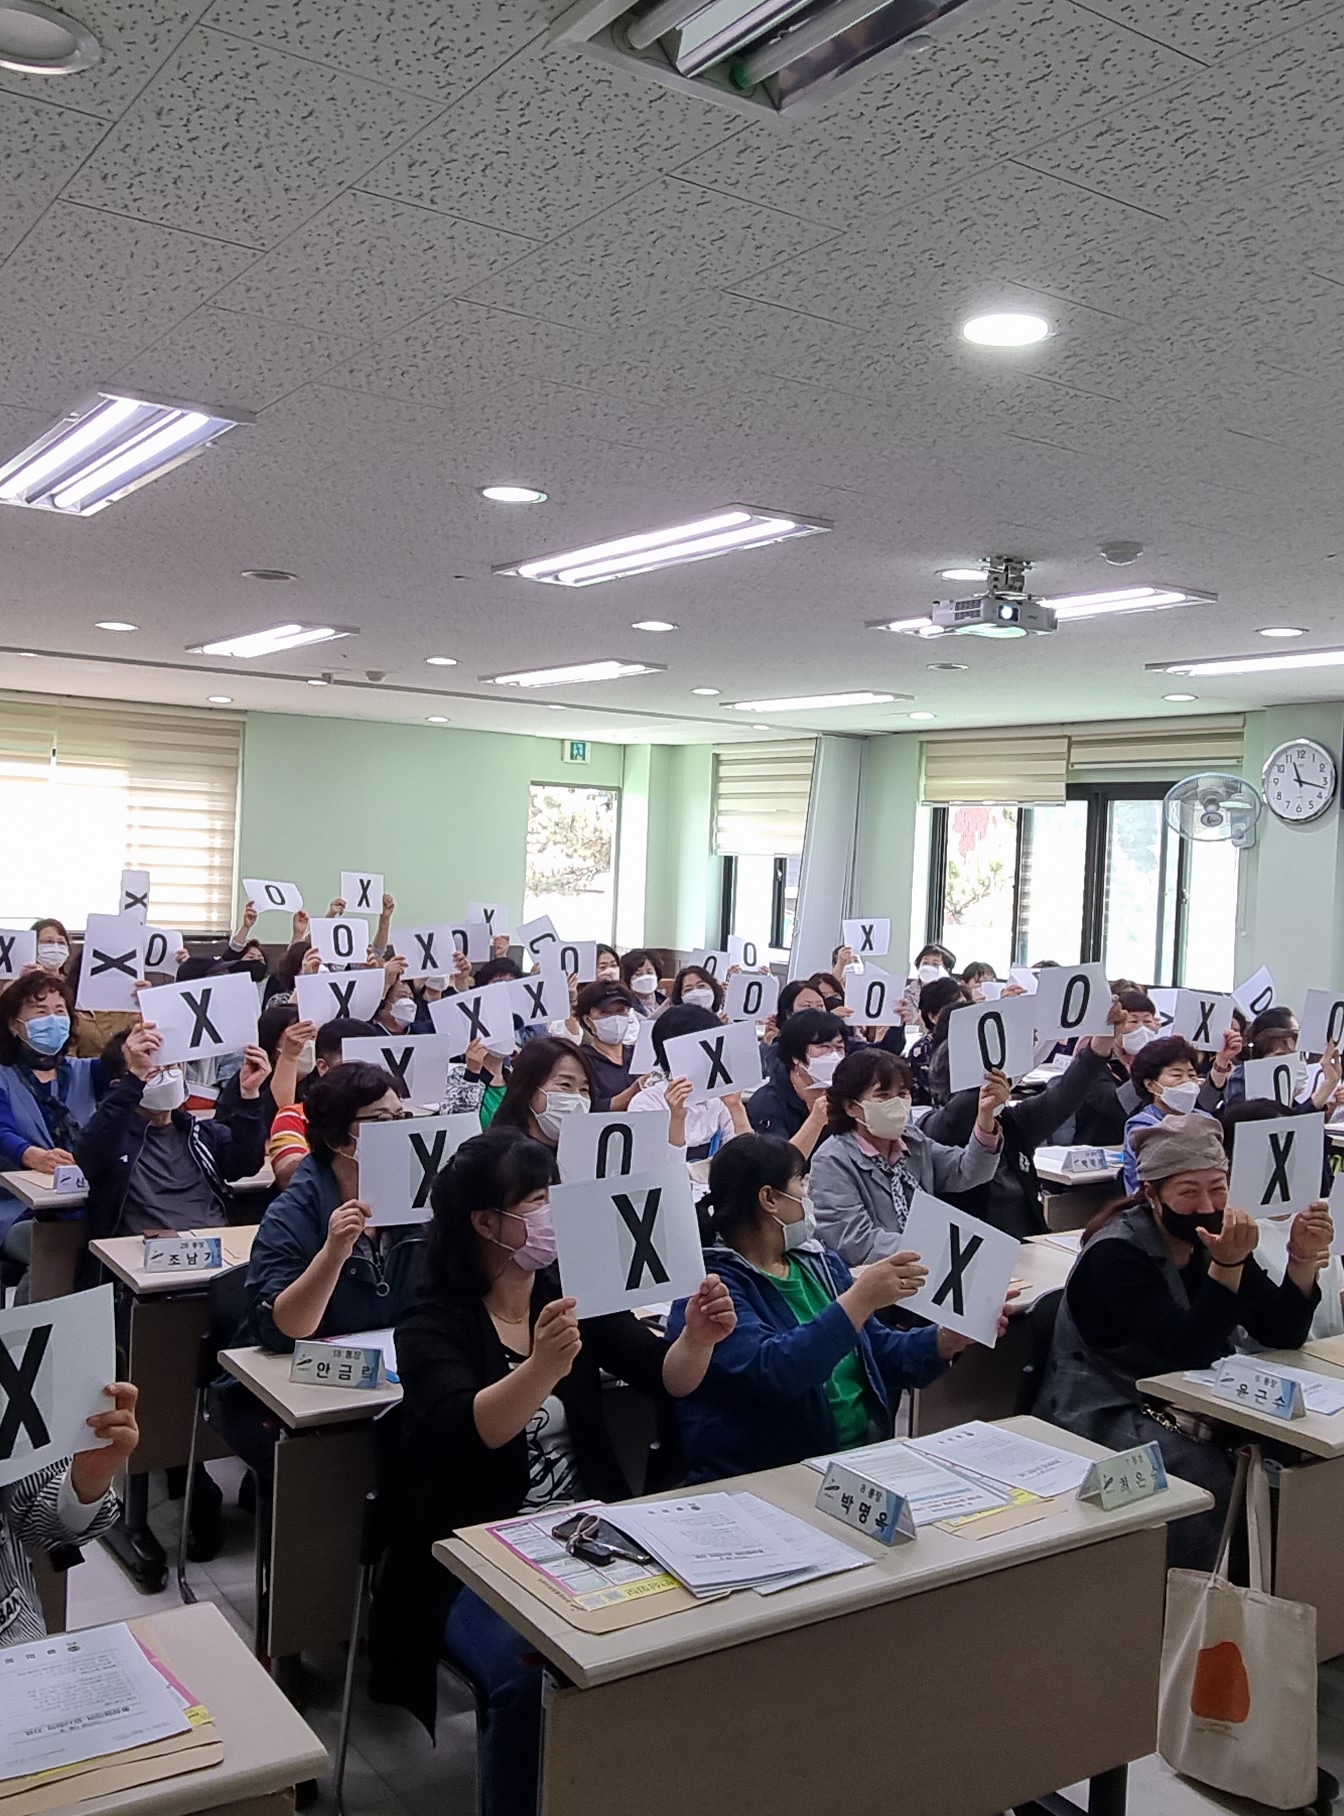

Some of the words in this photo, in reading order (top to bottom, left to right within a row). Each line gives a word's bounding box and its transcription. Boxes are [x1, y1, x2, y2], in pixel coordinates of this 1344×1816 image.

[1277, 764, 1285, 773] 10
[1285, 754, 1293, 764] 11
[1297, 750, 1306, 759] 12
[1312, 753, 1316, 762] 1
[1319, 763, 1326, 772] 2
[1273, 777, 1280, 786] 9
[1276, 791, 1282, 800] 8
[1317, 791, 1323, 799] 4
[1322, 777, 1328, 786] 3
[1285, 800, 1291, 809] 7
[1296, 804, 1302, 813] 6
[1308, 800, 1314, 810] 5
[124, 890, 148, 910] X
[265, 884, 286, 906] O
[357, 879, 372, 908] X
[145, 933, 167, 967] O
[333, 924, 353, 957] O
[414, 932, 439, 970] X
[860, 924, 874, 951] X
[90, 948, 138, 980] X
[743, 942, 757, 967] O
[328, 980, 356, 1020] X
[522, 981, 548, 1020] X
[743, 981, 763, 1015] O
[865, 981, 886, 1019] O
[1060, 974, 1091, 1029] O
[180, 988, 224, 1048] X
[456, 997, 492, 1042] X
[1192, 1001, 1215, 1044] X
[977, 1010, 1006, 1071] O
[698, 1036, 734, 1089] X
[1260, 1130, 1296, 1206] X
[611, 1187, 672, 1292] X
[931, 1223, 986, 1317] X
